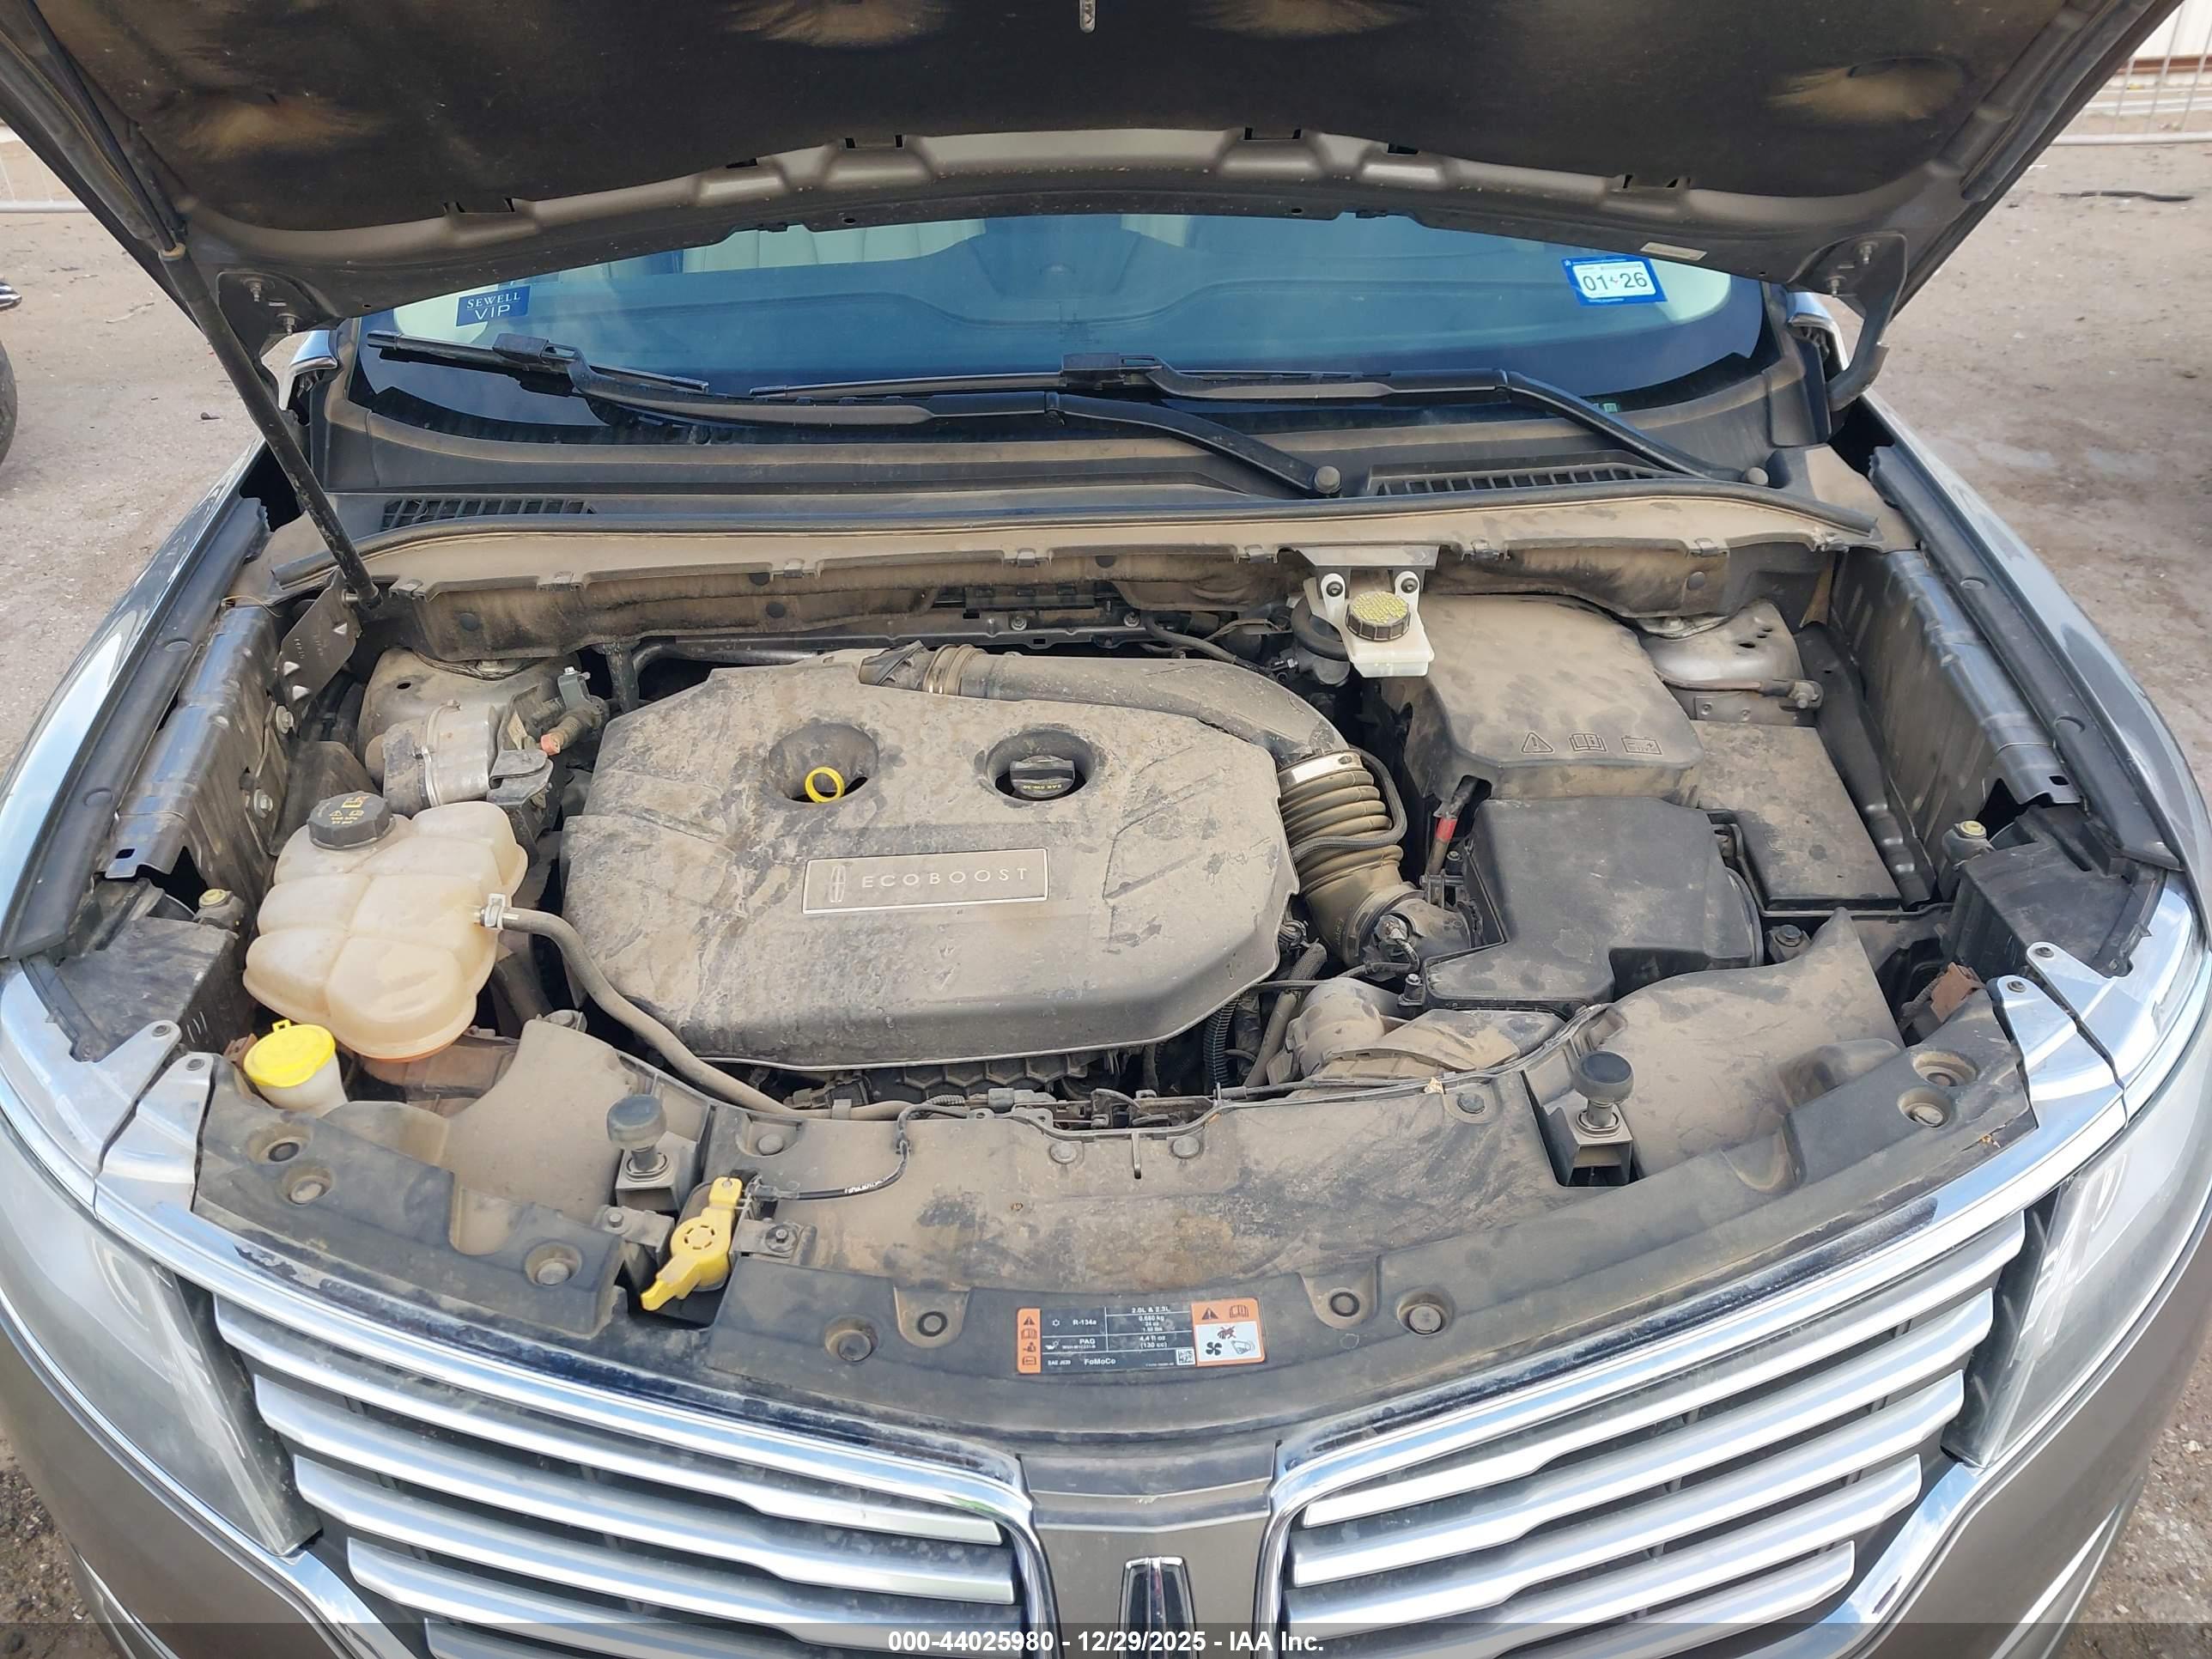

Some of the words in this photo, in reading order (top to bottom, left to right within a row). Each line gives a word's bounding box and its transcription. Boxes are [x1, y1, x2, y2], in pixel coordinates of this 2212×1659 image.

[1583, 275, 1608, 291] 01
[1620, 271, 1648, 289] 26
[466, 292, 521, 308] SEWELL
[474, 304, 511, 320] VIP
[861, 867, 1028, 889] ECOBOOST
[1084, 1358, 1116, 1366] FoMoCo
